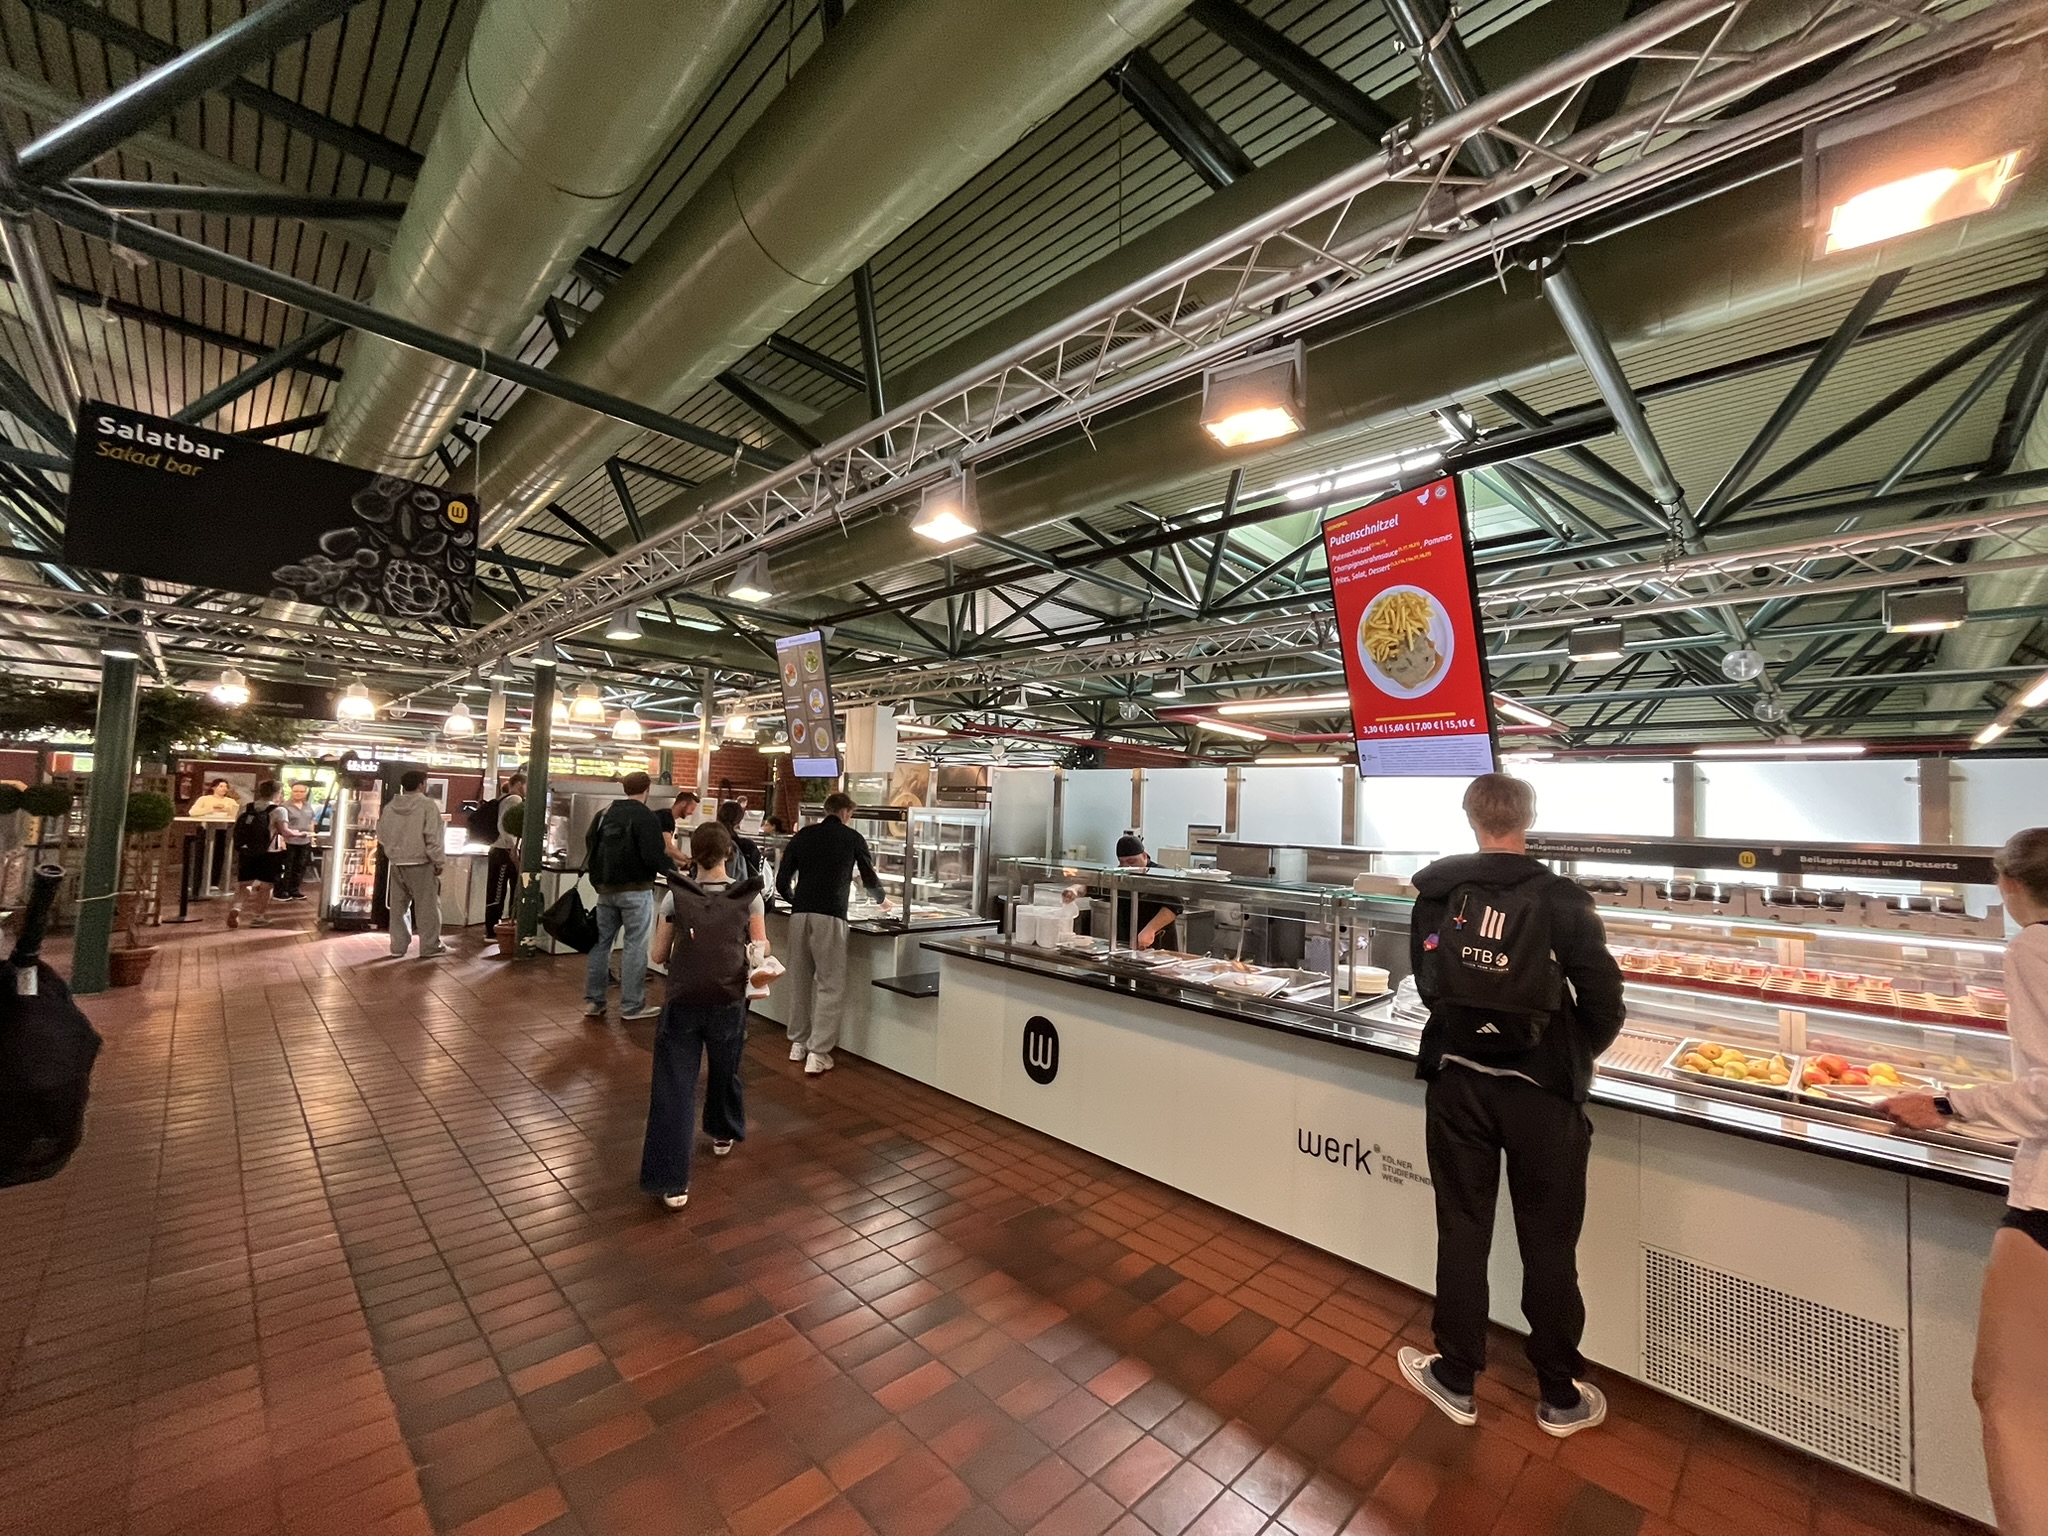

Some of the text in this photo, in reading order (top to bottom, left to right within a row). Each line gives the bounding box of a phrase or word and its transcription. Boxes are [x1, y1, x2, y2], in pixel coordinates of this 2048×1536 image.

[97, 416, 225, 460] Salatbar
[95, 441, 203, 477] Salad bar
[1330, 514, 1398, 547] Putenschnitzel
[1424, 533, 1453, 547] Pommes
[1368, 563, 1390, 576] Dessert
[1363, 725, 1377, 734] 3,30
[1388, 724, 1404, 732] 5,60
[1416, 722, 1432, 732] 7,00
[1434, 722, 1439, 730] €
[1446, 720, 1468, 730] 15,10
[1469, 719, 1476, 728] €
[1524, 843, 1578, 852] Beilagensalate
[1596, 846, 1632, 854] Desserts
[1800, 856, 1958, 870] Beilagensalate und Desserts
[1462, 946, 1493, 964] PTB
[1298, 1128, 1372, 1175] werk
[1382, 1173, 1404, 1186] WERK
